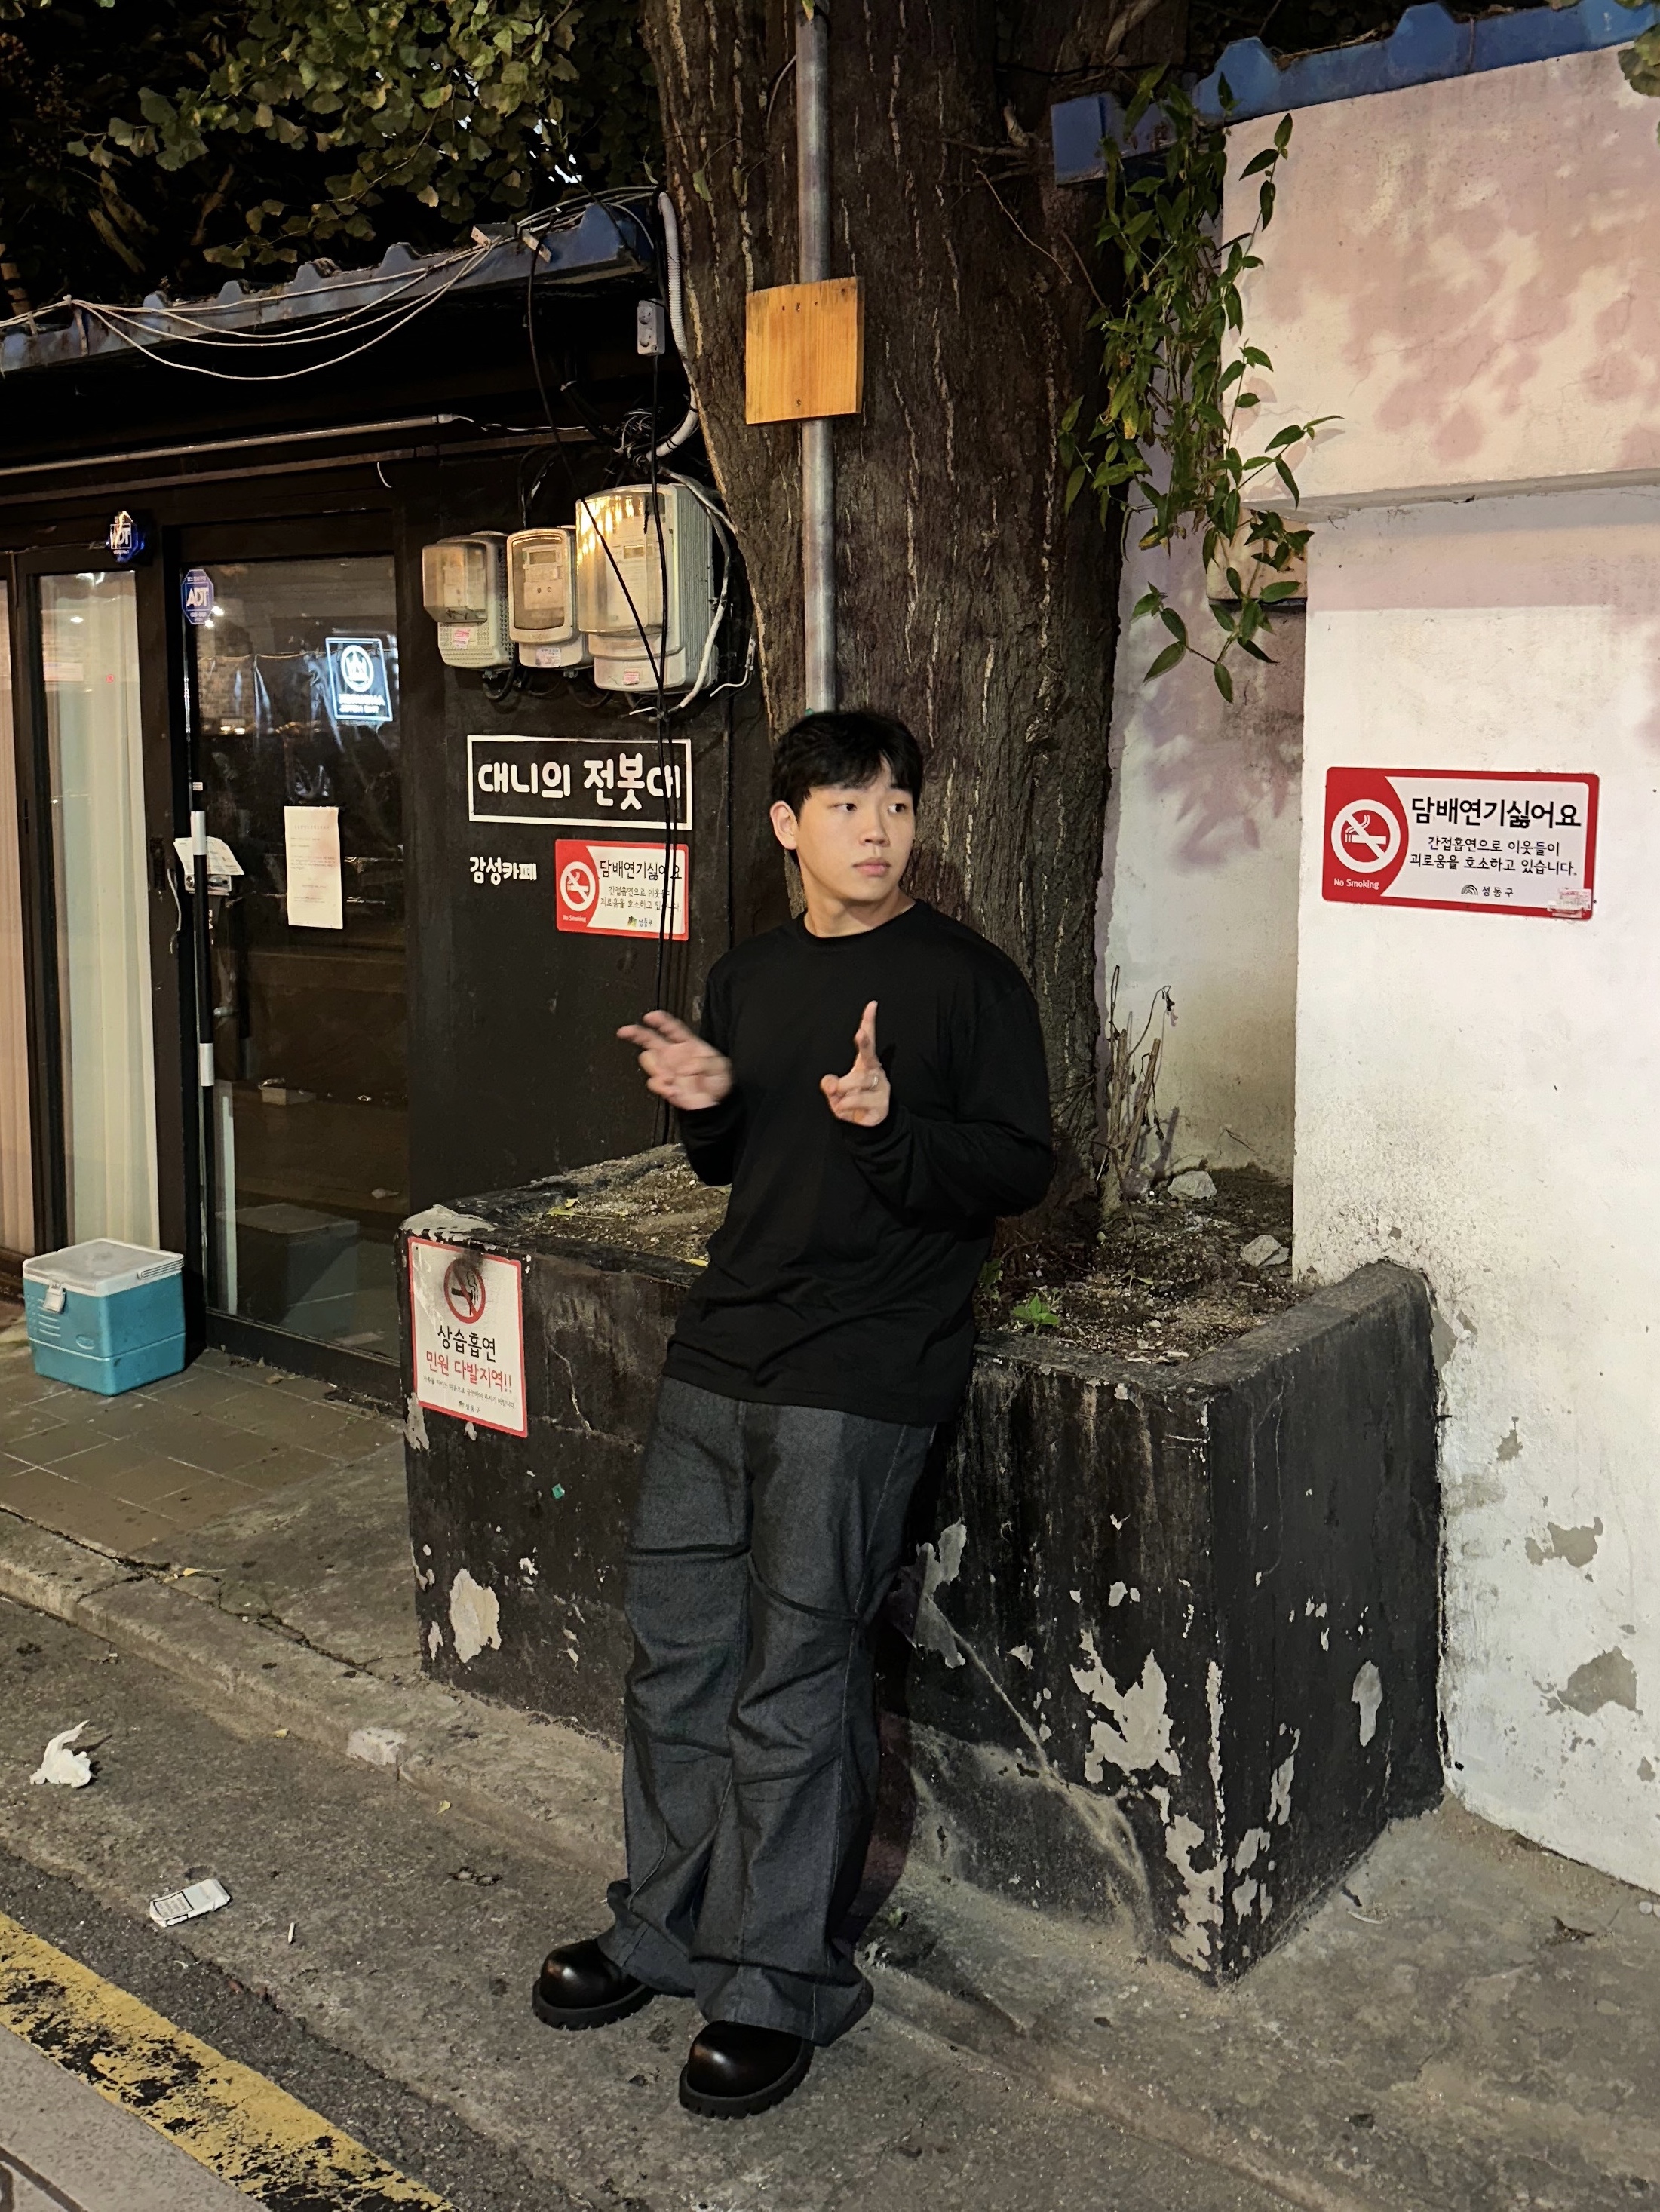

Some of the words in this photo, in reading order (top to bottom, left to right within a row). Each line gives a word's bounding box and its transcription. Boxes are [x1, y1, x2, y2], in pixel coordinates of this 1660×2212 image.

[186, 587, 209, 607] ADT
[477, 761, 571, 799] 대니의
[583, 753, 680, 811] 전봇대
[1412, 796, 1582, 829] 담배연기싫어요
[1427, 836, 1502, 852] 간접흡연으로
[1508, 839, 1560, 856] 이웃들이
[469, 856, 537, 885] 감성카페
[1409, 853, 1459, 870] 괴로움을
[1464, 857, 1516, 872] 호소하고
[1521, 858, 1577, 876] 있습니다.
[1333, 877, 1344, 887] No
[1345, 879, 1379, 890] Smoking
[437, 1324, 496, 1363] 상습흡연
[426, 1351, 450, 1376] 민원
[454, 1359, 512, 1394] 다발지역!!
